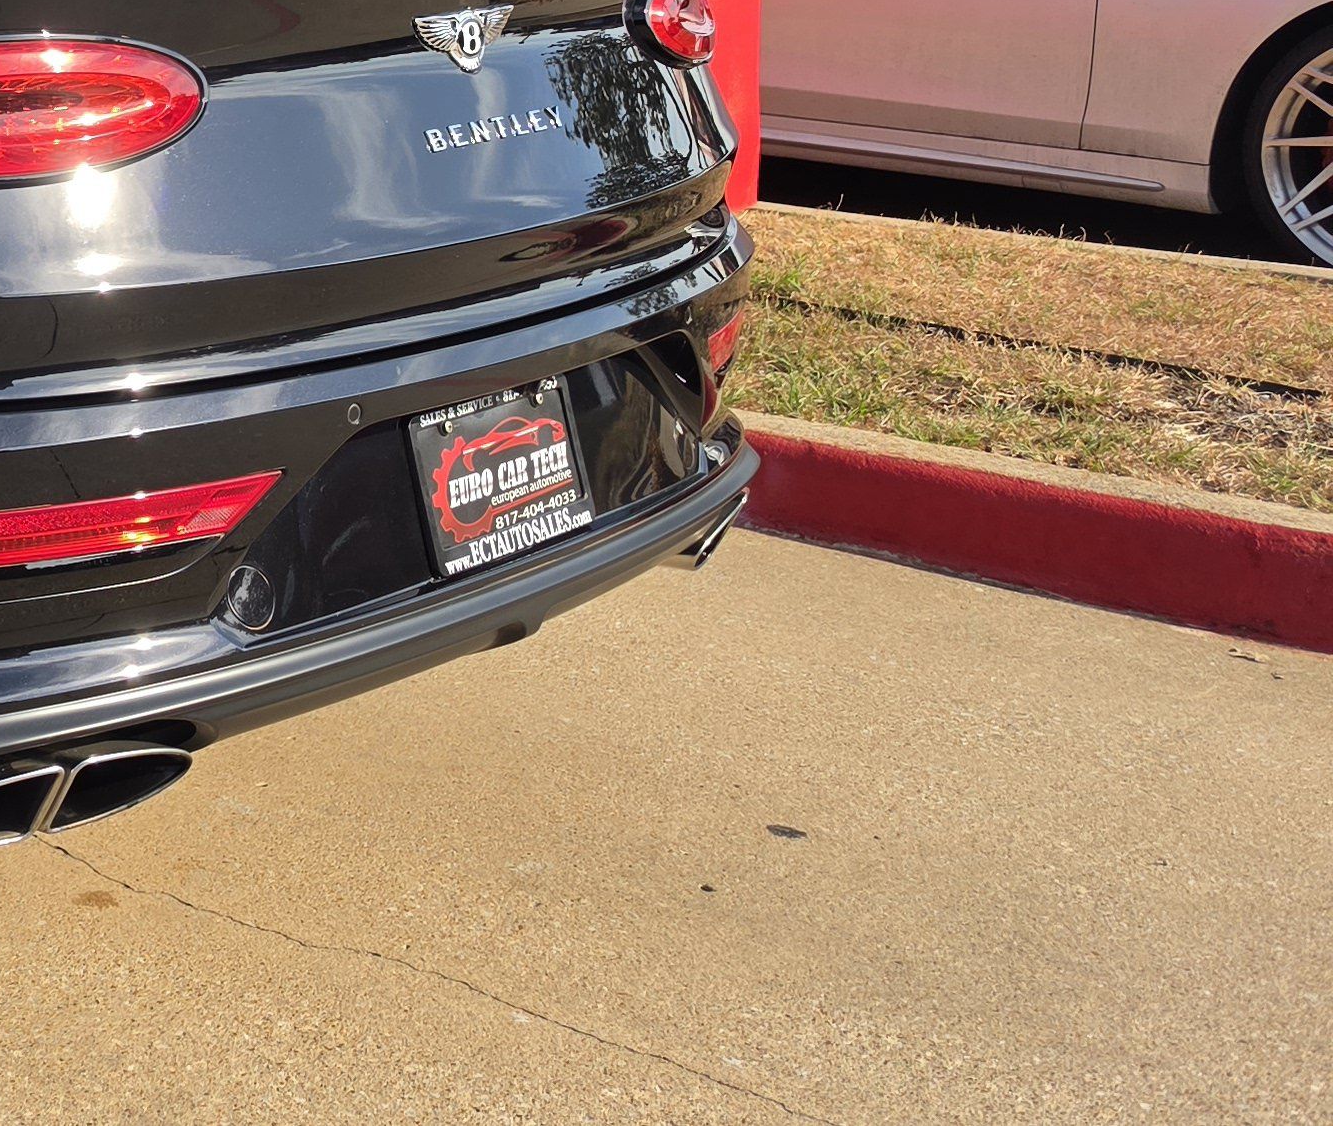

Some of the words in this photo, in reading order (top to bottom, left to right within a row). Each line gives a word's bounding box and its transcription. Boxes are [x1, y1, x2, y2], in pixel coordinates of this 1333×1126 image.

[424, 105, 563, 153] BENTLEY
[419, 407, 447, 427] SALES
[447, 405, 456, 419] &
[456, 394, 494, 417] SERVICE
[449, 467, 493, 509] EURO
[497, 455, 528, 491] CAR
[530, 440, 569, 479] TECH
[491, 482, 530, 507] european
[529, 468, 573, 495] automotive
[495, 488, 577, 530] 817-404-4033
[445, 508, 593, 575] www.ECTAUTOSALES.com
